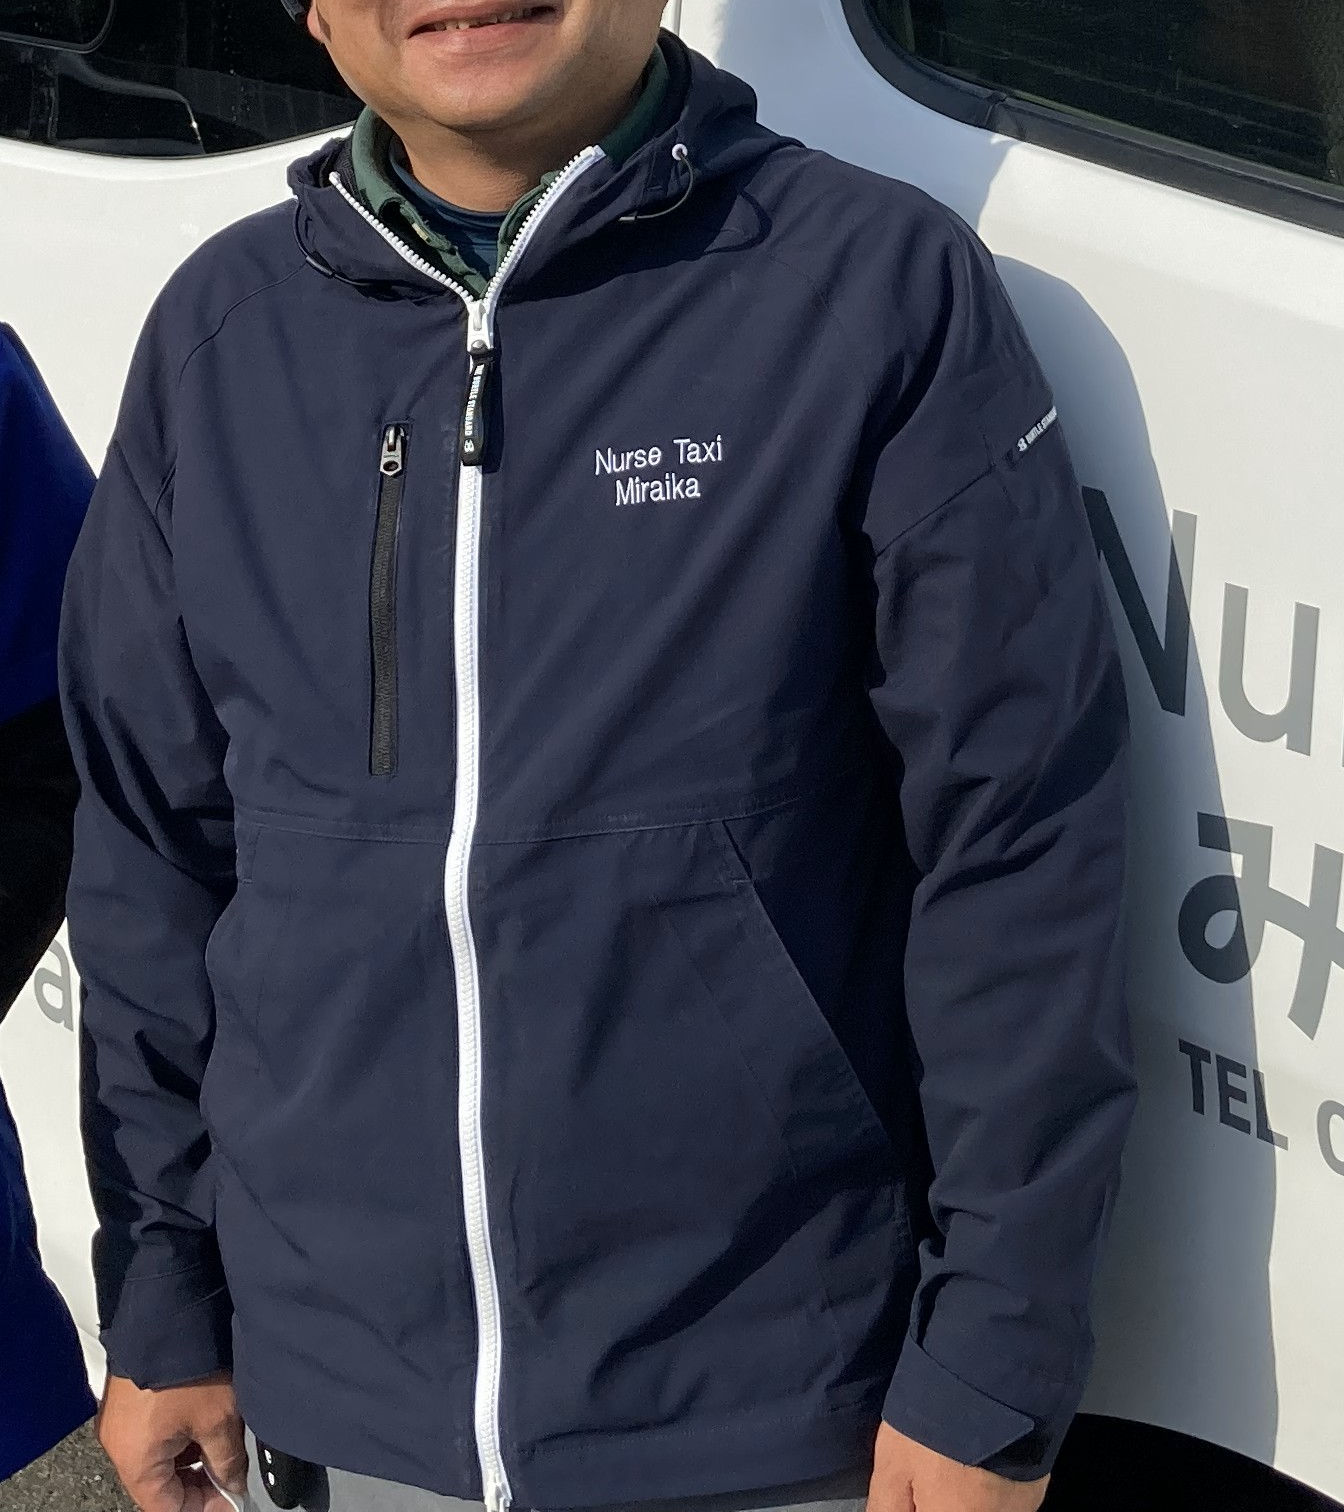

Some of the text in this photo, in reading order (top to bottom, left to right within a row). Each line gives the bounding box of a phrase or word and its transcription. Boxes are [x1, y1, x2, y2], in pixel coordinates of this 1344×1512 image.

[594, 434, 723, 476] Nurse Taxi
[614, 472, 701, 506] Miraika
[1177, 1037, 1288, 1150] TEL
